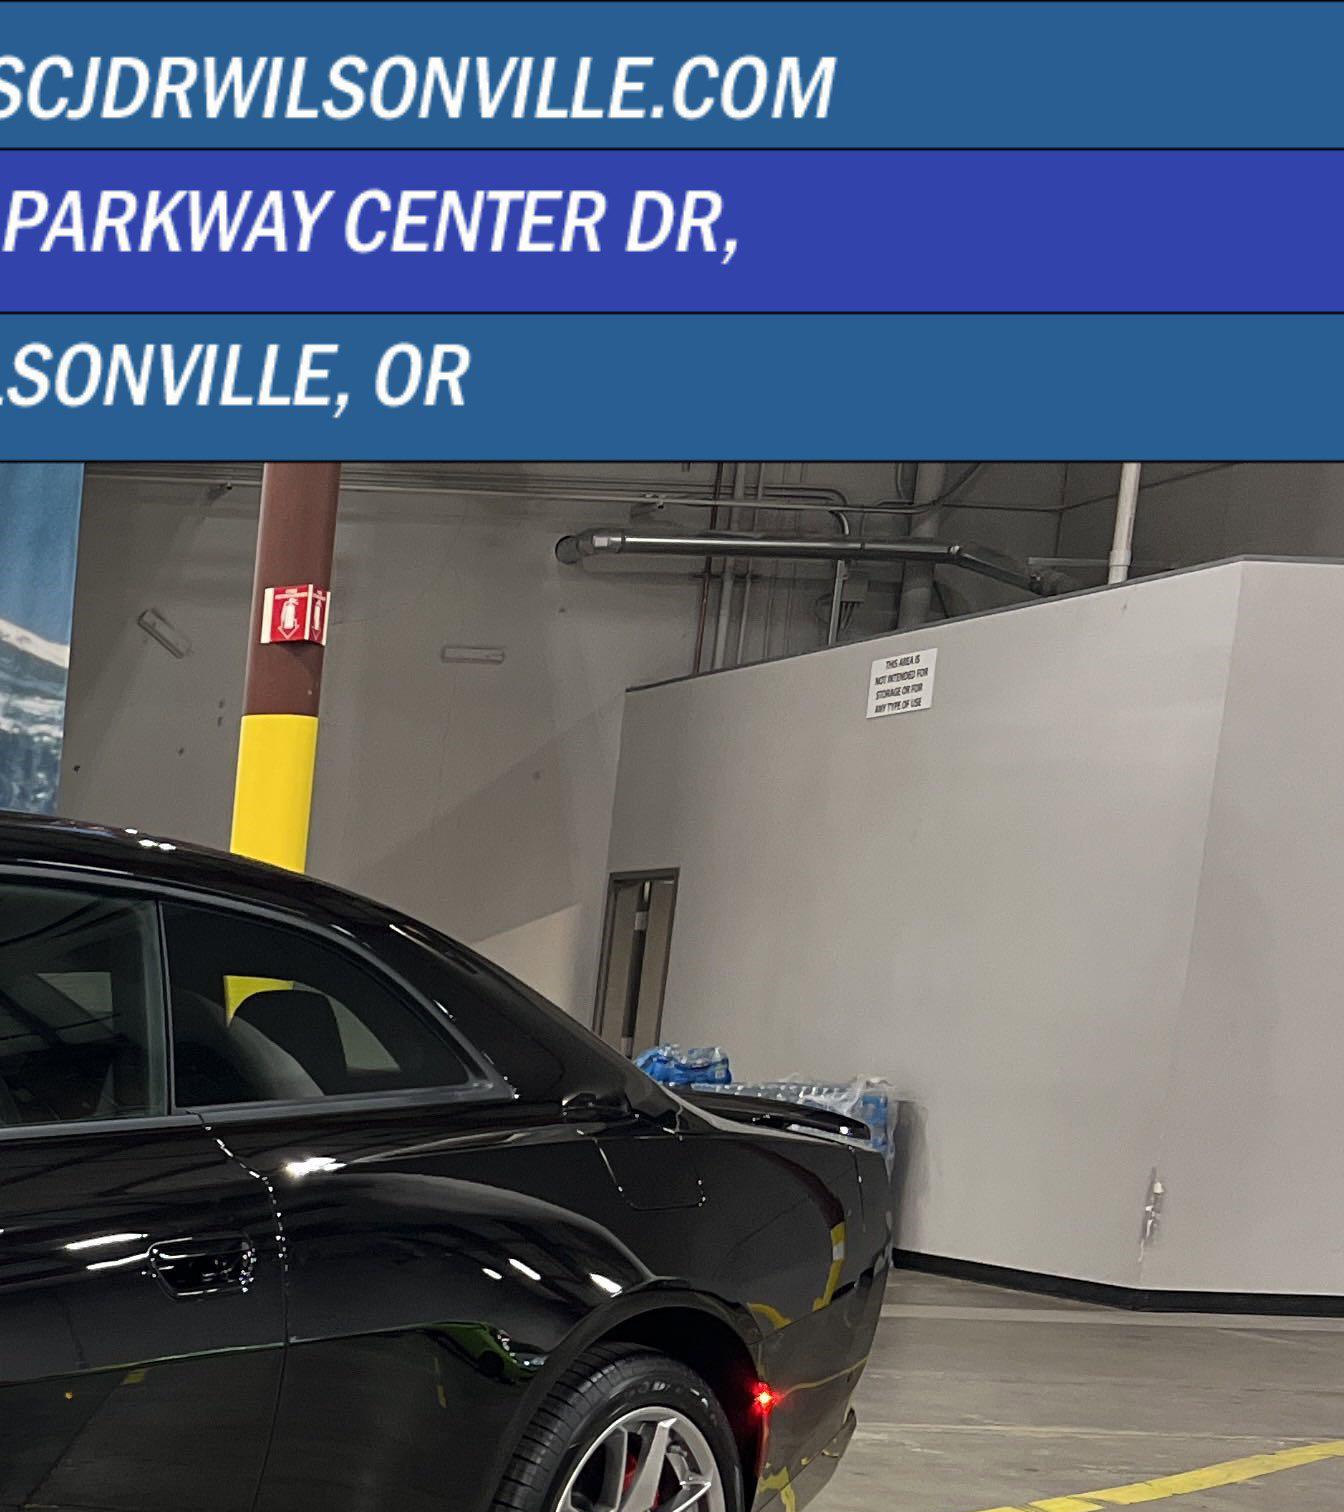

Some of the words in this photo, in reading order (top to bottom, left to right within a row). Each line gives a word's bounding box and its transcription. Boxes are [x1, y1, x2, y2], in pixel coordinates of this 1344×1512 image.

[886, 659, 898, 669] THIS
[899, 656, 914, 666] AREA
[915, 654, 921, 664] IS
[875, 675, 887, 685] NOT
[887, 670, 916, 683] INTENDED
[917, 667, 929, 677] FOR
[876, 687, 901, 700] STORAGE
[902, 685, 911, 695] OR
[911, 683, 923, 692] FOR
[888, 701, 901, 711] TYPE
[902, 699, 910, 709] OF
